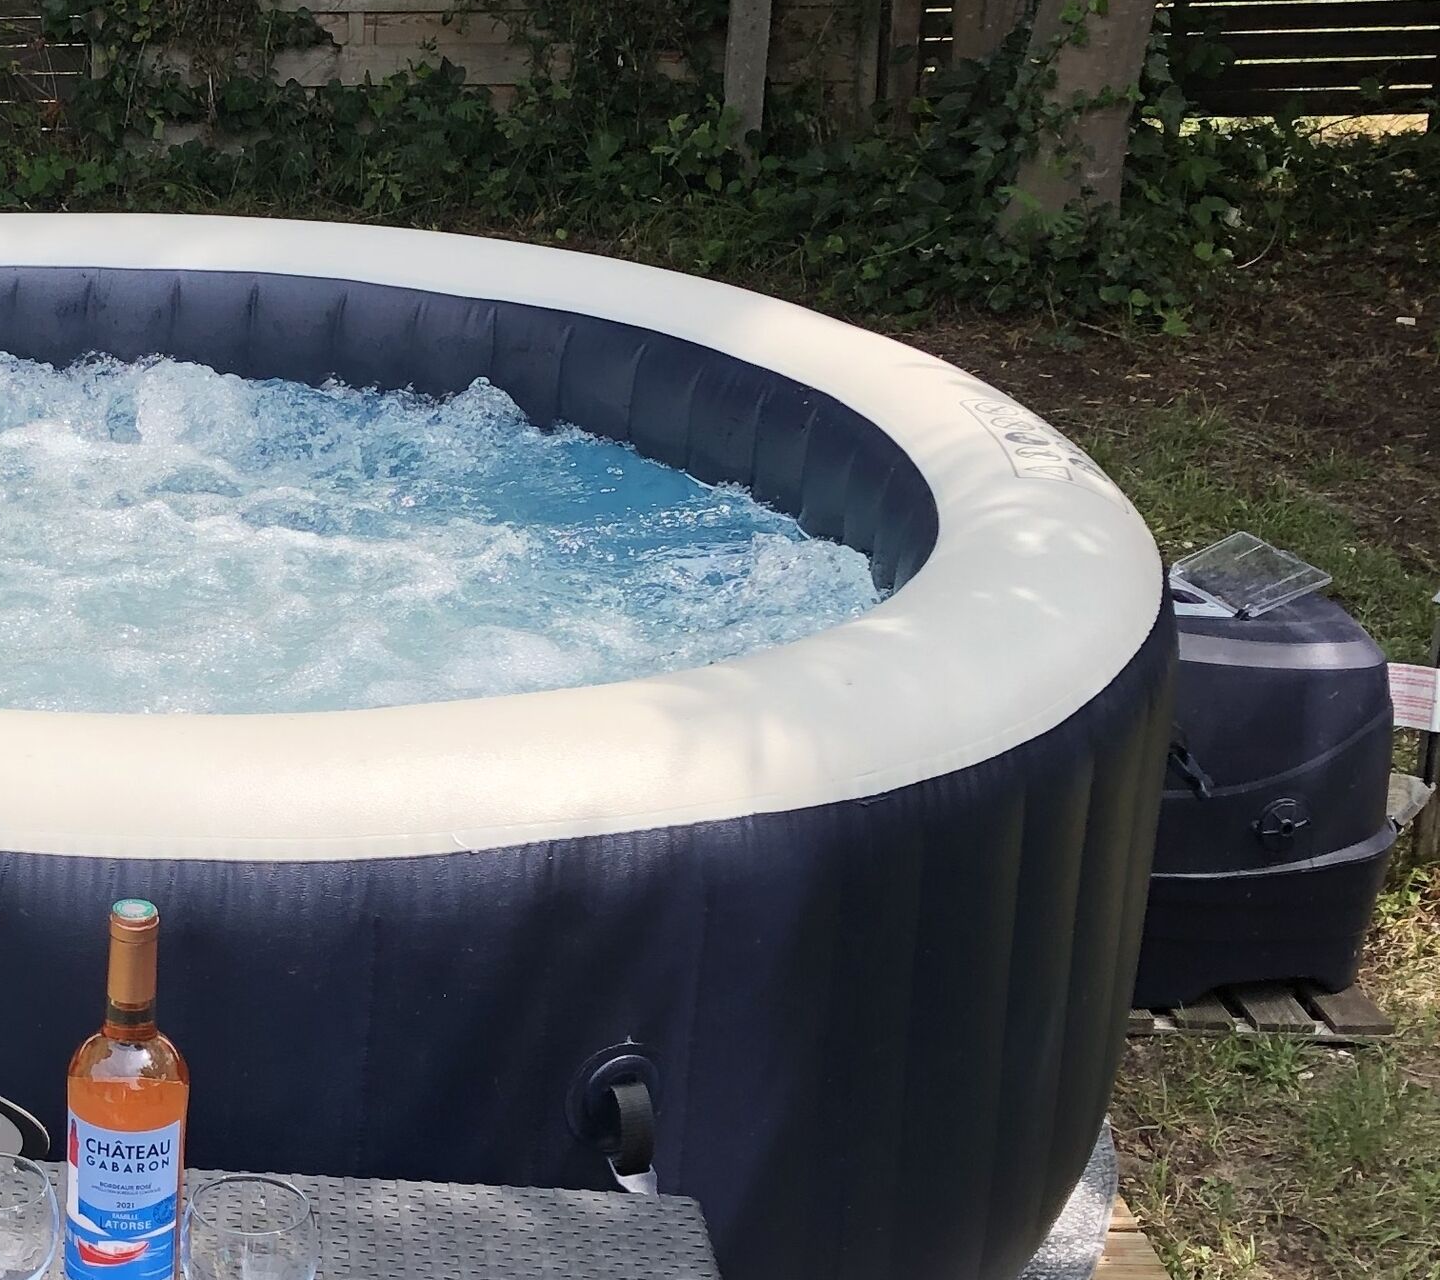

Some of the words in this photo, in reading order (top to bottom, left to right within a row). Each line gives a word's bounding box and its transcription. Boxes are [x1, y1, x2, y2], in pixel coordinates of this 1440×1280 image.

[85, 1137, 171, 1160] CHÂTEAU
[86, 1155, 170, 1174] GABARON
[116, 1201, 135, 1209] 2021
